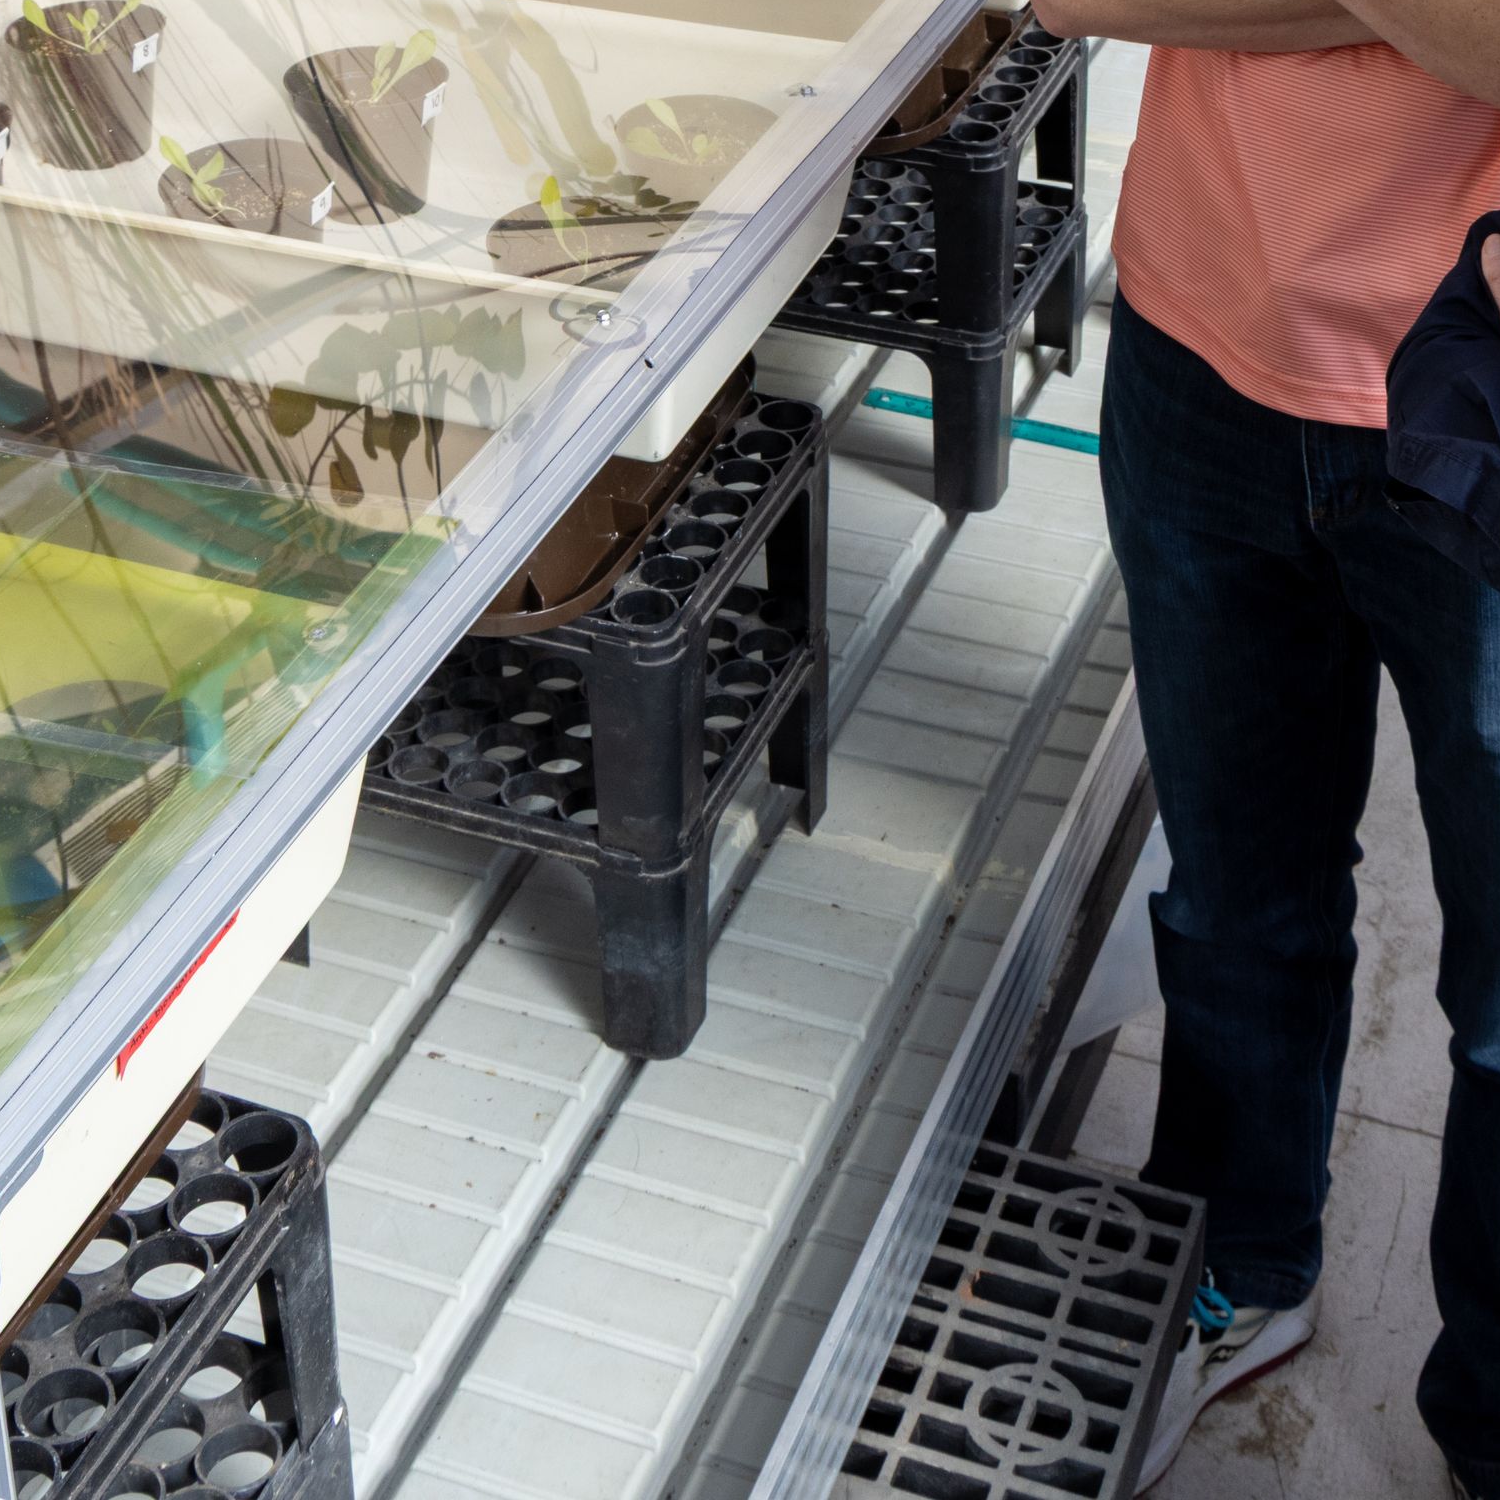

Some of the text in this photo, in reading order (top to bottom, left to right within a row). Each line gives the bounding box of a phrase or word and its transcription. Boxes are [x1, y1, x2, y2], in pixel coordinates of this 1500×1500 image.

[143, 43, 150, 57] 8
[432, 94, 440, 108] 10
[319, 196, 326, 209] 9
